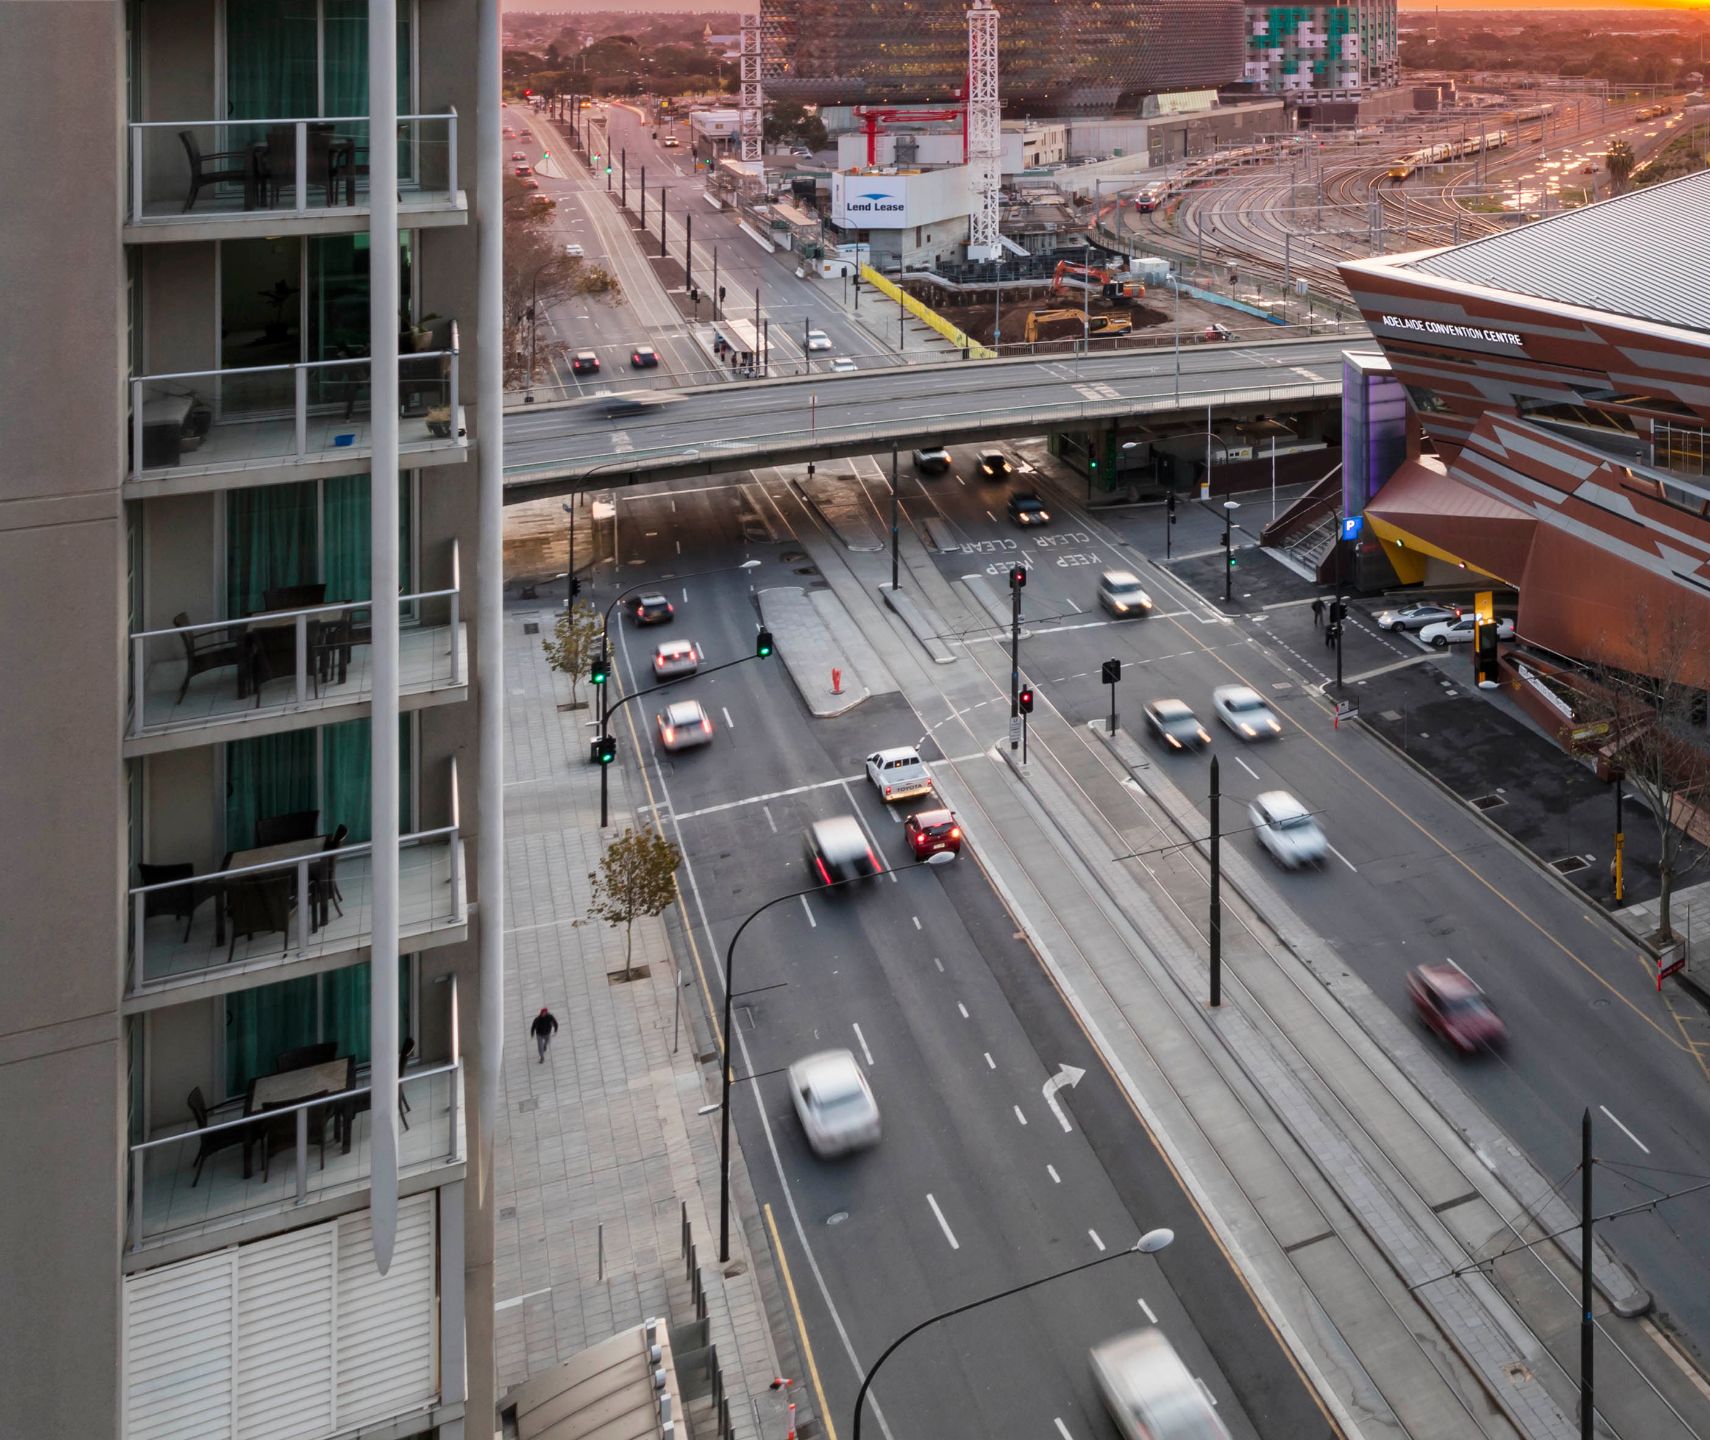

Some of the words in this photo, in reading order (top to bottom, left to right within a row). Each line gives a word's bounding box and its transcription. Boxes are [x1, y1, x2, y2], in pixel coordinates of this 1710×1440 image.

[846, 202, 872, 212] Lend
[874, 202, 905, 212] Lease
[1382, 315, 1426, 331] ADELAIDE
[1425, 321, 1484, 340] CONVENTION
[1483, 329, 1524, 346] CENTRE
[1346, 520, 1355, 531] P
[960, 539, 1018, 553] CLEAR
[1033, 532, 1090, 547] CLEAR
[1057, 552, 1103, 568] KEEP
[896, 783, 923, 792] TOYOTA
